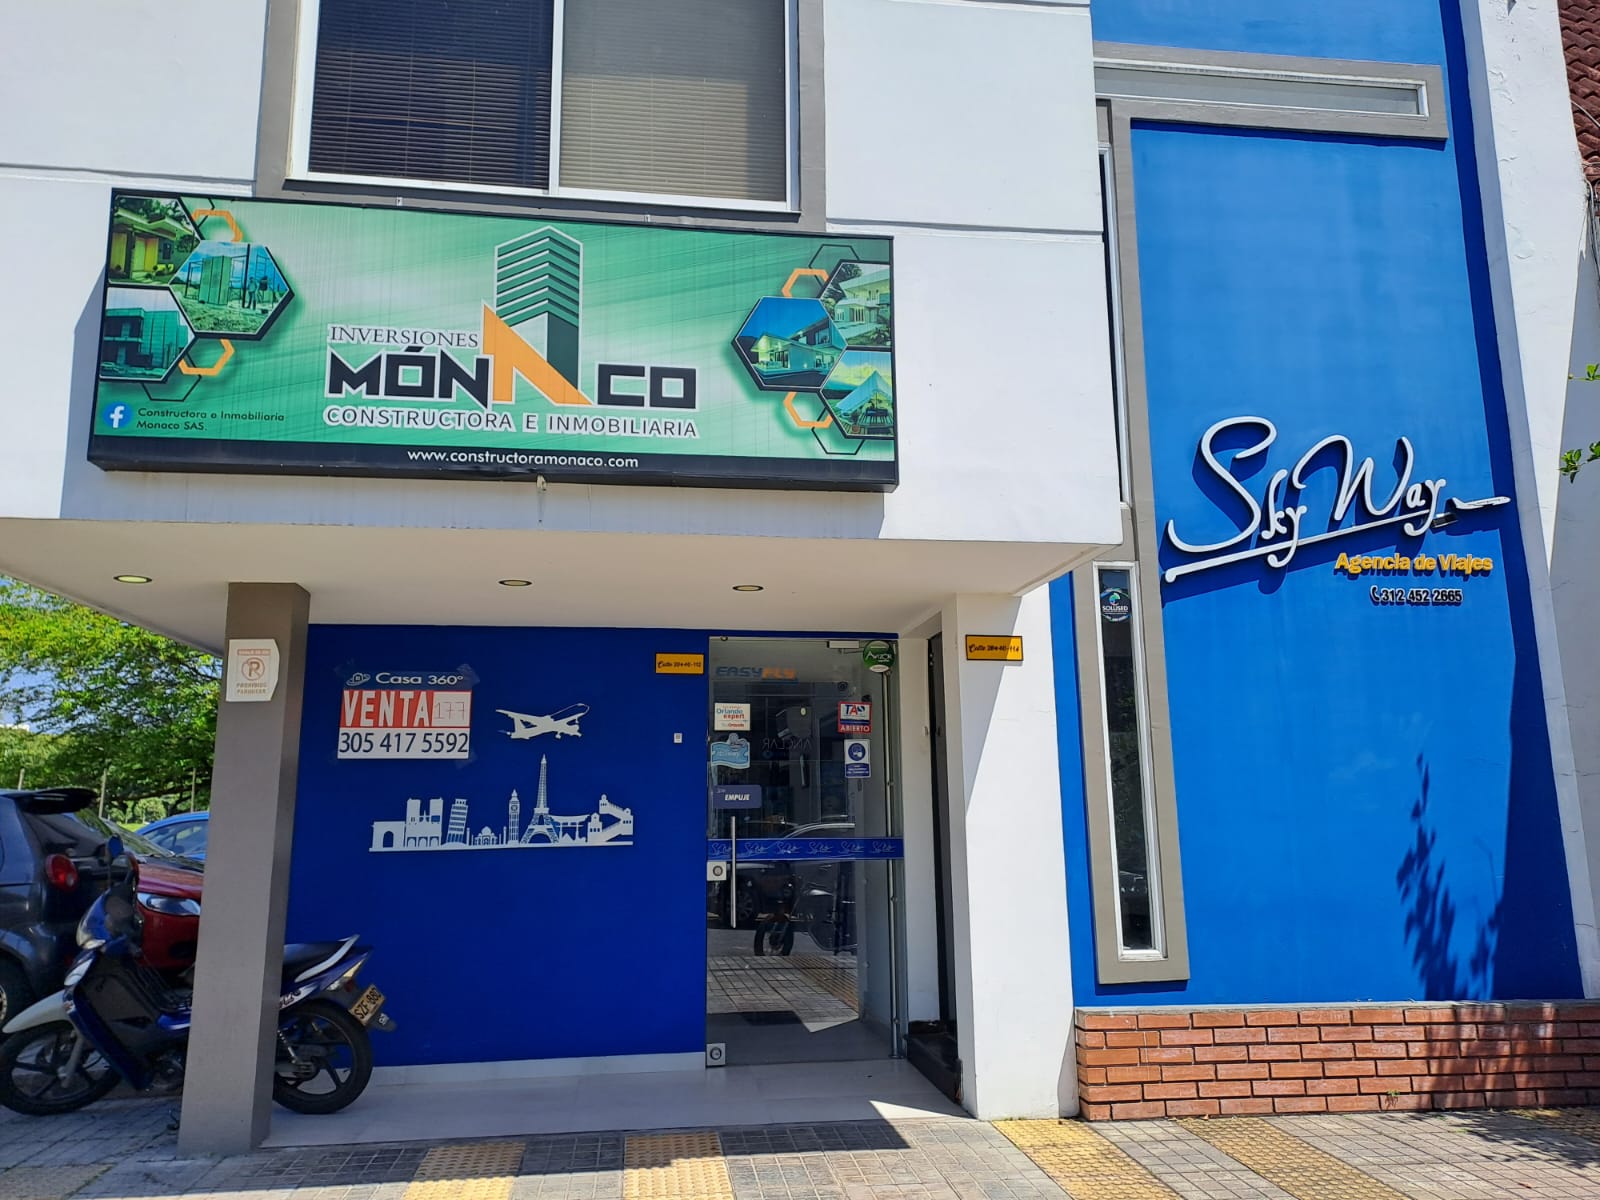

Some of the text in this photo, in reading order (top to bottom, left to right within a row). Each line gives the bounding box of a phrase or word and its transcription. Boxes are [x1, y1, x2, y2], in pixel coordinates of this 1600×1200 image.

[329, 325, 479, 348] INVERSIONES
[136, 420, 180, 430] Monaco
[137, 407, 207, 419] Constructora
[220, 410, 285, 422] Inmobiliaria
[326, 407, 698, 437] CONSTRUCTORA E INMOBILIARIA
[407, 450, 639, 469] www.constructoramonaco.com
[1167, 415, 1447, 569] Sky Way
[1334, 552, 1494, 575] Agencia de Viajes
[1381, 588, 1463, 603] 312 452 2665
[375, 672, 422, 684] Casa
[343, 690, 430, 727] VENTA
[339, 732, 469, 753] 305 417 5592
